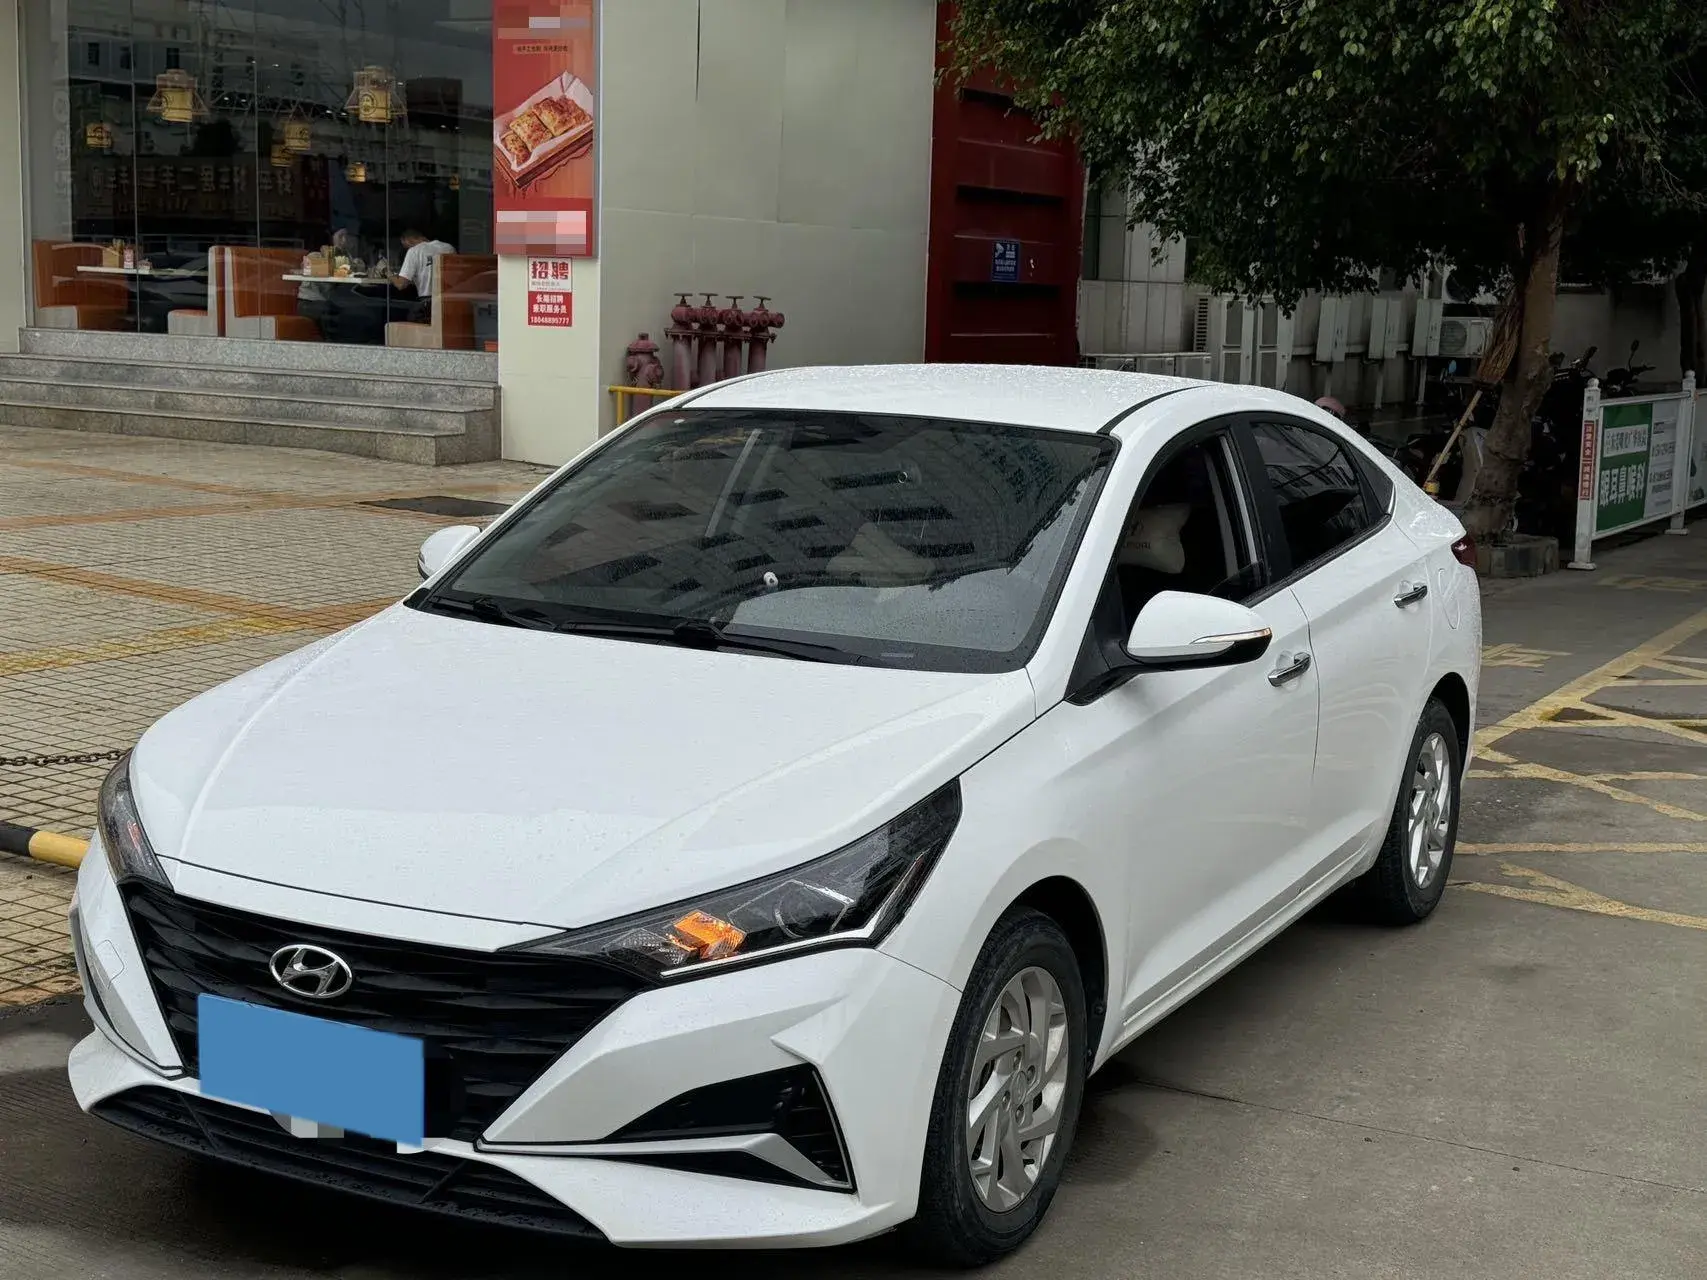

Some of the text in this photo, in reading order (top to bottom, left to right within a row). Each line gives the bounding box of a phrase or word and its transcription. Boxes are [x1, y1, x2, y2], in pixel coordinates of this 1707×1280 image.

[531, 261, 569, 280] 招聘
[1600, 463, 1645, 507] 眼耳鼻喉科
